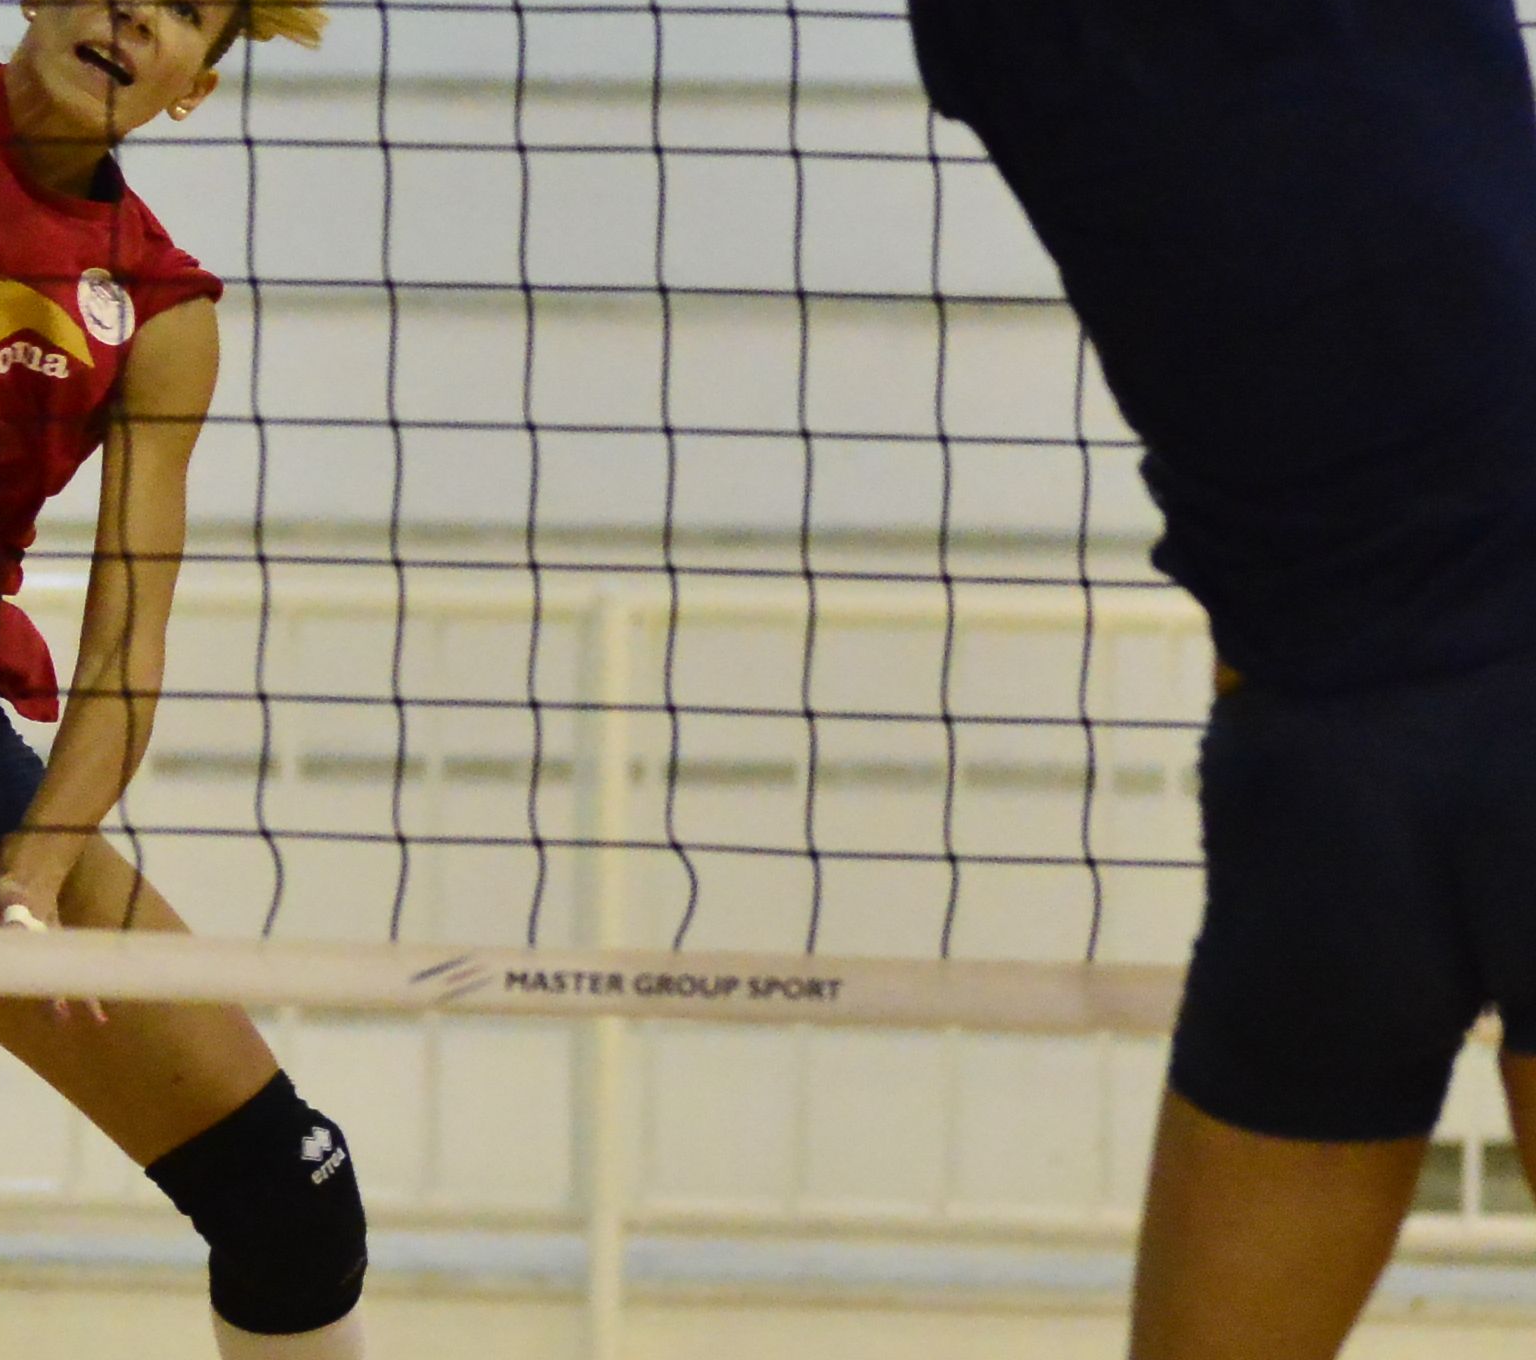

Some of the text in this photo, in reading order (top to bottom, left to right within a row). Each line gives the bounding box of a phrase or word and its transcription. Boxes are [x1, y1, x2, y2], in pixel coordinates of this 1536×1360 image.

[504, 970, 843, 1000] MASTER GROUP SPORT
